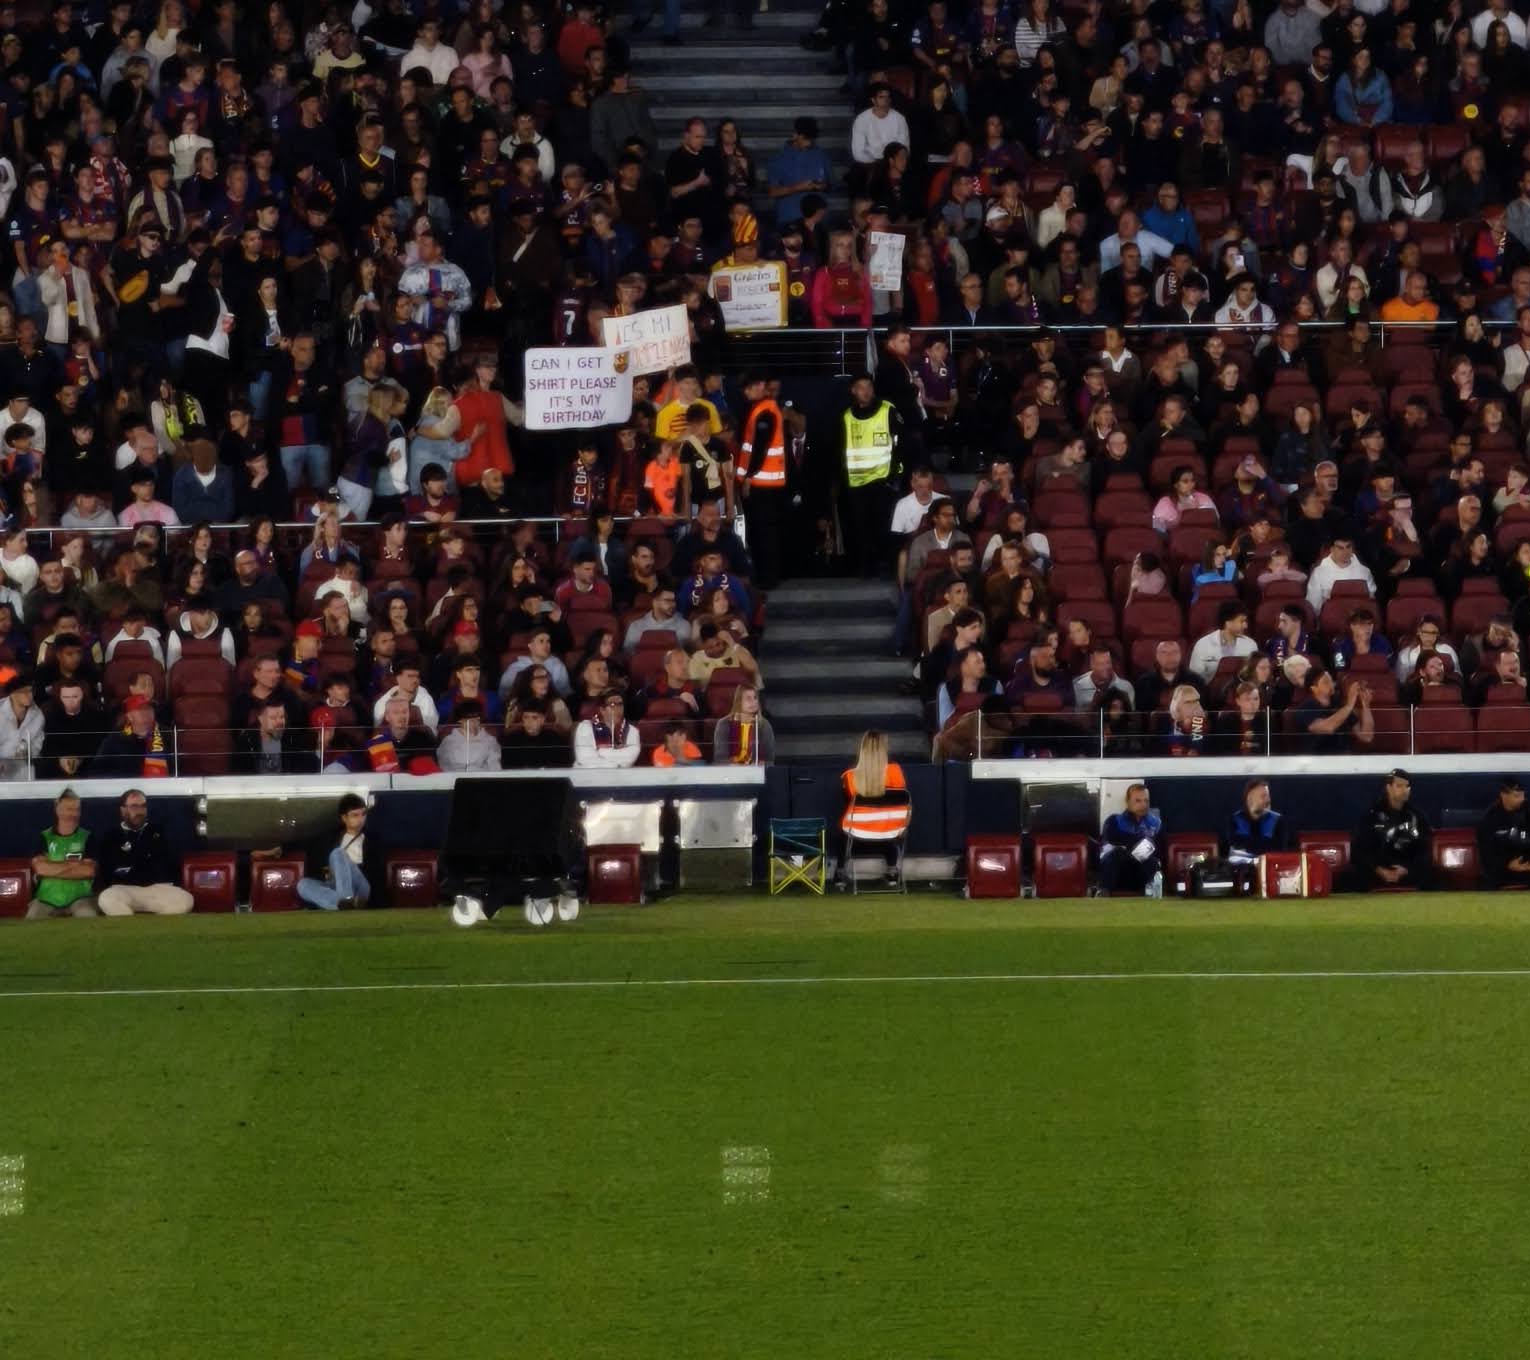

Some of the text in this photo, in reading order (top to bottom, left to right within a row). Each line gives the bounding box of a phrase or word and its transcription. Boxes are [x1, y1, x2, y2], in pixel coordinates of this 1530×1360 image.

[563, 310, 576, 336] 7
[531, 356, 560, 370] CAN
[577, 356, 604, 370] GET
[529, 376, 617, 391] SHIRT PLEASE
[550, 393, 602, 409] IT'S MY
[543, 409, 606, 424] BIRTHDAY
